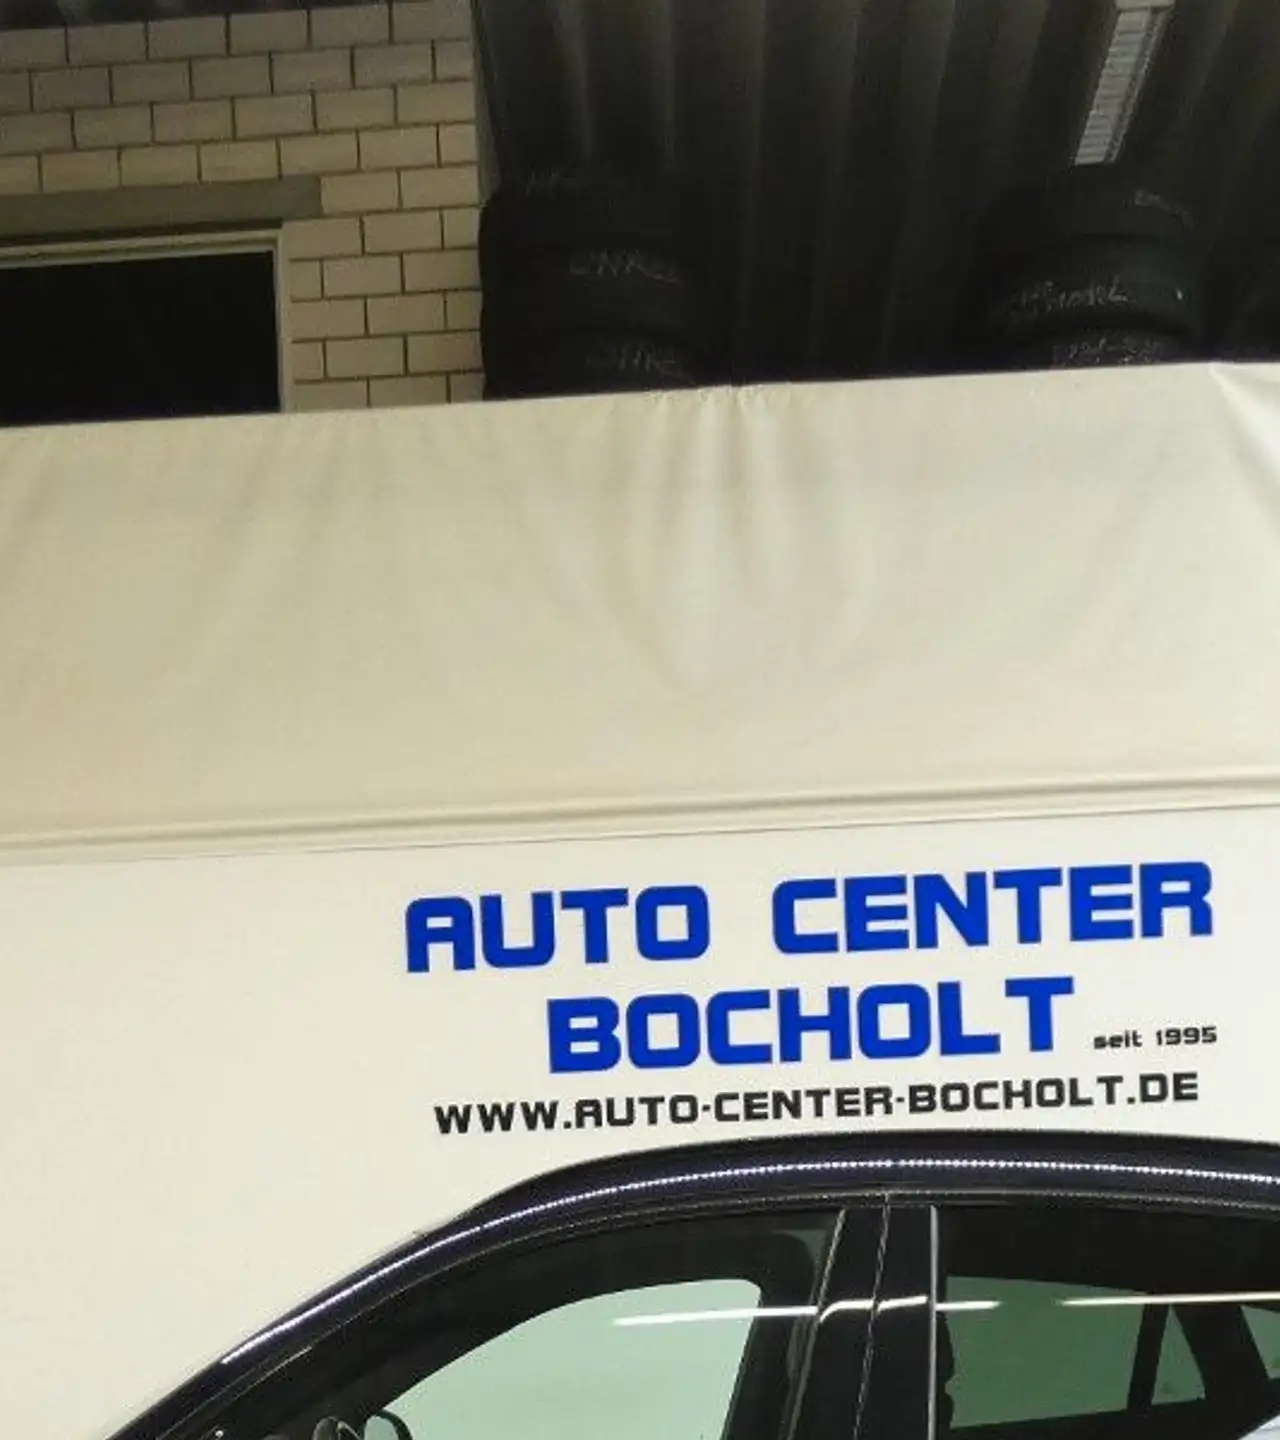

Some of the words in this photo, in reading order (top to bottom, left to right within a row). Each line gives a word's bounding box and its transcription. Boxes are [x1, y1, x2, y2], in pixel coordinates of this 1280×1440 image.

[406, 884, 711, 974] AUTO
[772, 860, 1214, 956] CENTER
[546, 975, 1075, 1075] BOCHOLT
[1093, 1030, 1142, 1050] seit
[1155, 1026, 1217, 1046] 1995
[433, 1072, 1199, 1135] WWW.AUTO-CENTER-BOCHOLT.DE
